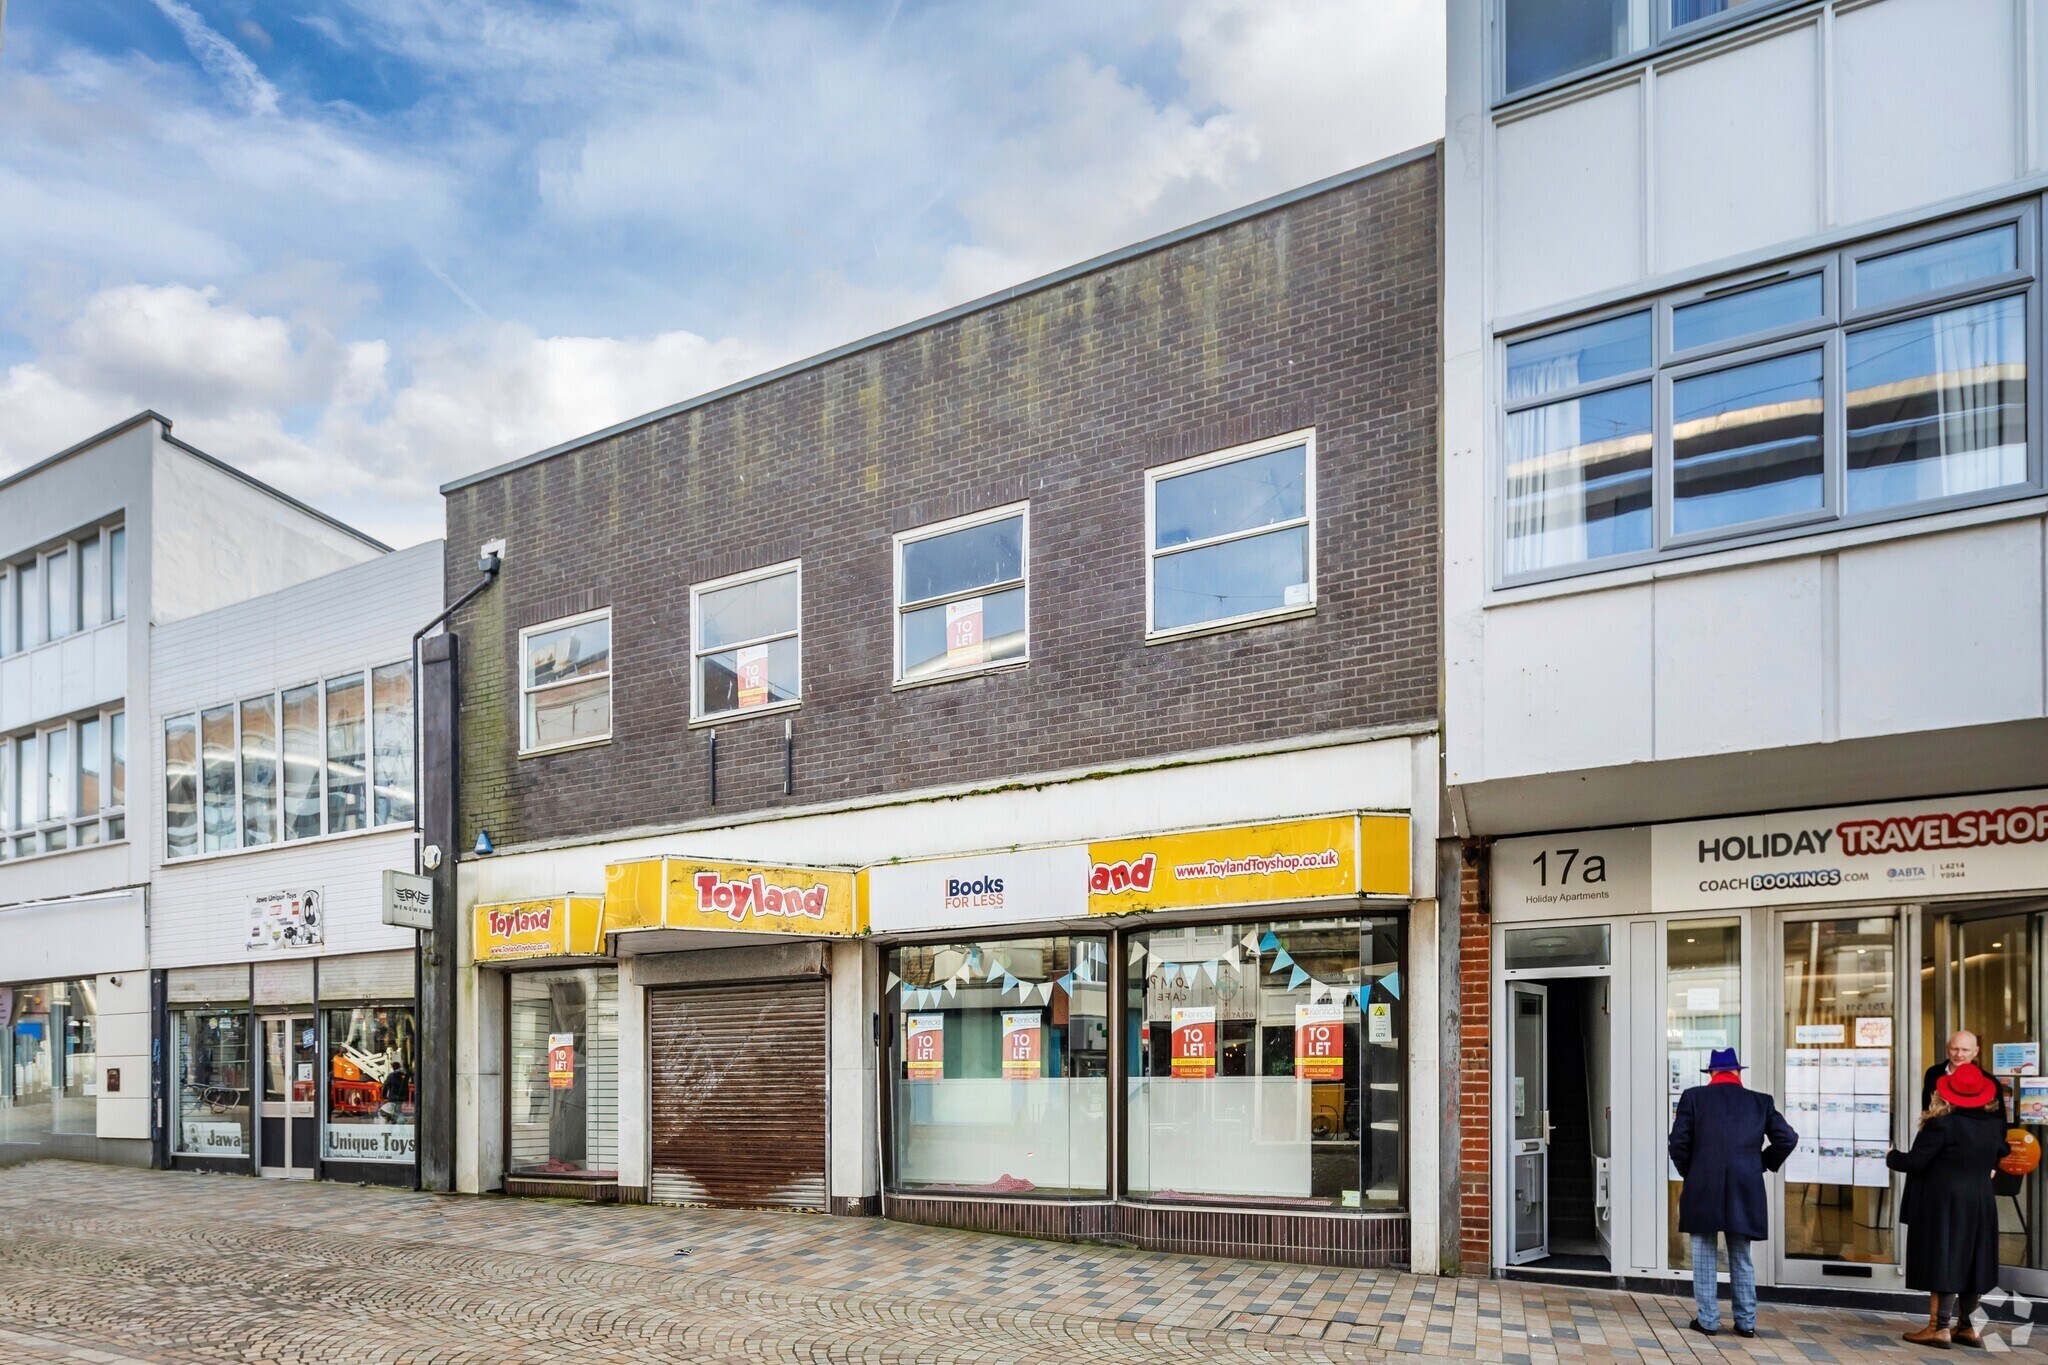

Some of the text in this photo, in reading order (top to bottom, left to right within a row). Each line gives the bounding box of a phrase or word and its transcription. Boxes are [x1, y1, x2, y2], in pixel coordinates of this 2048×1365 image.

[957, 620, 972, 633] TO
[956, 633, 973, 646] LET
[745, 664, 759, 676] TO
[745, 676, 759, 688] LET
[1699, 828, 1833, 863] HOLIDAY
[1176, 851, 1336, 877] www.ToylandToyshop.co.uk
[1533, 848, 1606, 886] 17a
[1088, 857, 1154, 892] and
[1897, 867, 1925, 877] ABTA
[949, 875, 1004, 897] Books
[286, 892, 297, 900] Toys
[697, 875, 826, 918] Toyland
[945, 893, 1004, 909] FOR LESS
[1526, 891, 1609, 904] Holiday Apartments
[393, 904, 431, 914] MENSWEAR
[489, 908, 551, 938] Toyland
[1310, 1006, 1340, 1015] Kenricks
[1013, 1034, 1030, 1046] TO
[1183, 1028, 1203, 1042] TO
[1308, 1026, 1330, 1041] TO
[917, 1035, 933, 1047] TO
[555, 1050, 567, 1060] TO
[917, 1048, 934, 1060] LET
[1013, 1047, 1031, 1059] LET
[1183, 1043, 1204, 1056] LET
[1308, 1041, 1331, 1056] LET
[555, 1061, 567, 1071] LET
[207, 1129, 241, 1147] Jawa
[329, 1131, 415, 1153] Unique Toys
